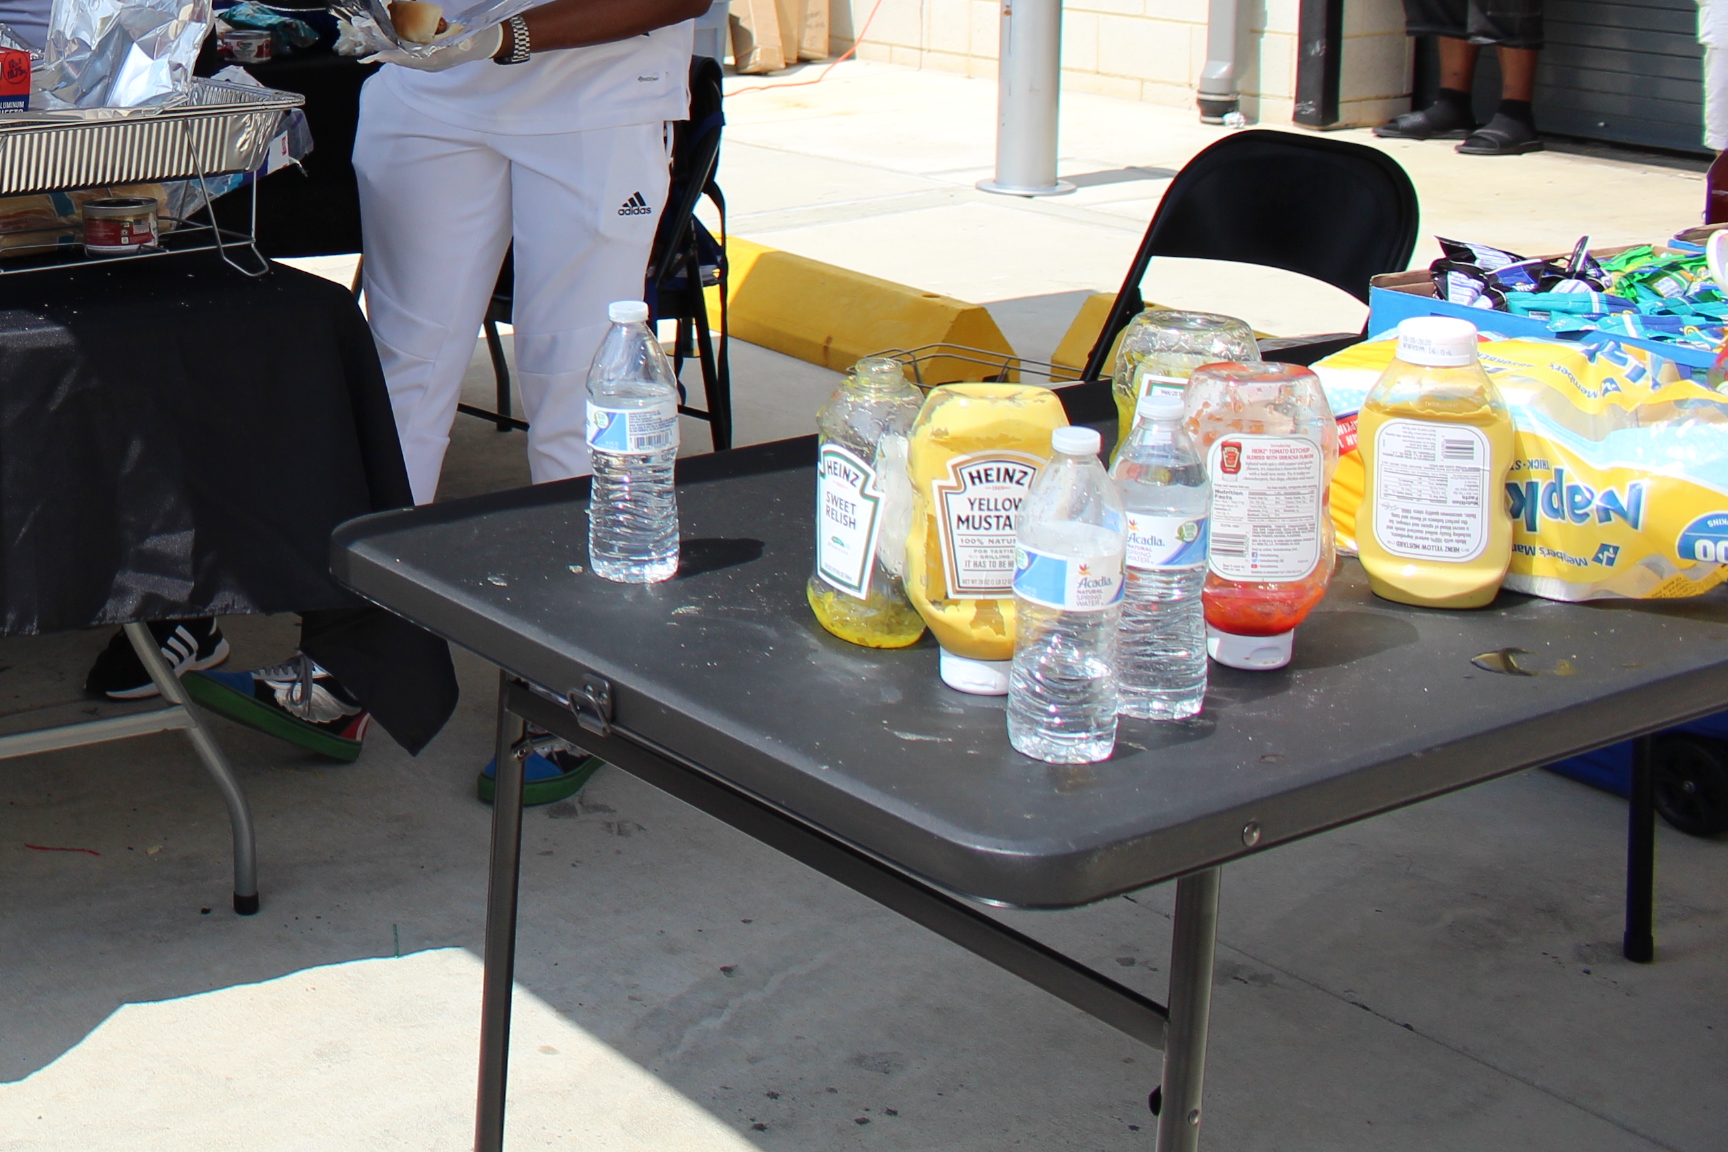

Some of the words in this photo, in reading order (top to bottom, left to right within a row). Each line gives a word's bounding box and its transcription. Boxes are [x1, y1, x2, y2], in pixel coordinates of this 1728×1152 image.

[618, 206, 652, 216] adidas
[1548, 362, 1598, 400] Member's
[826, 460, 859, 487] HEINZ
[967, 467, 1029, 486] HEINZ
[826, 491, 856, 516] SWEET
[1505, 468, 1646, 532] Napk
[825, 504, 857, 530] RELISH
[1127, 549, 1151, 558] SPRING
[1396, 541, 1420, 549] MUSTARD
[1422, 544, 1443, 552] YELLOW
[1512, 544, 1536, 557] Mar
[965, 560, 971, 568] IT
[973, 560, 986, 568] HAS
[1539, 546, 1589, 567] Member's
